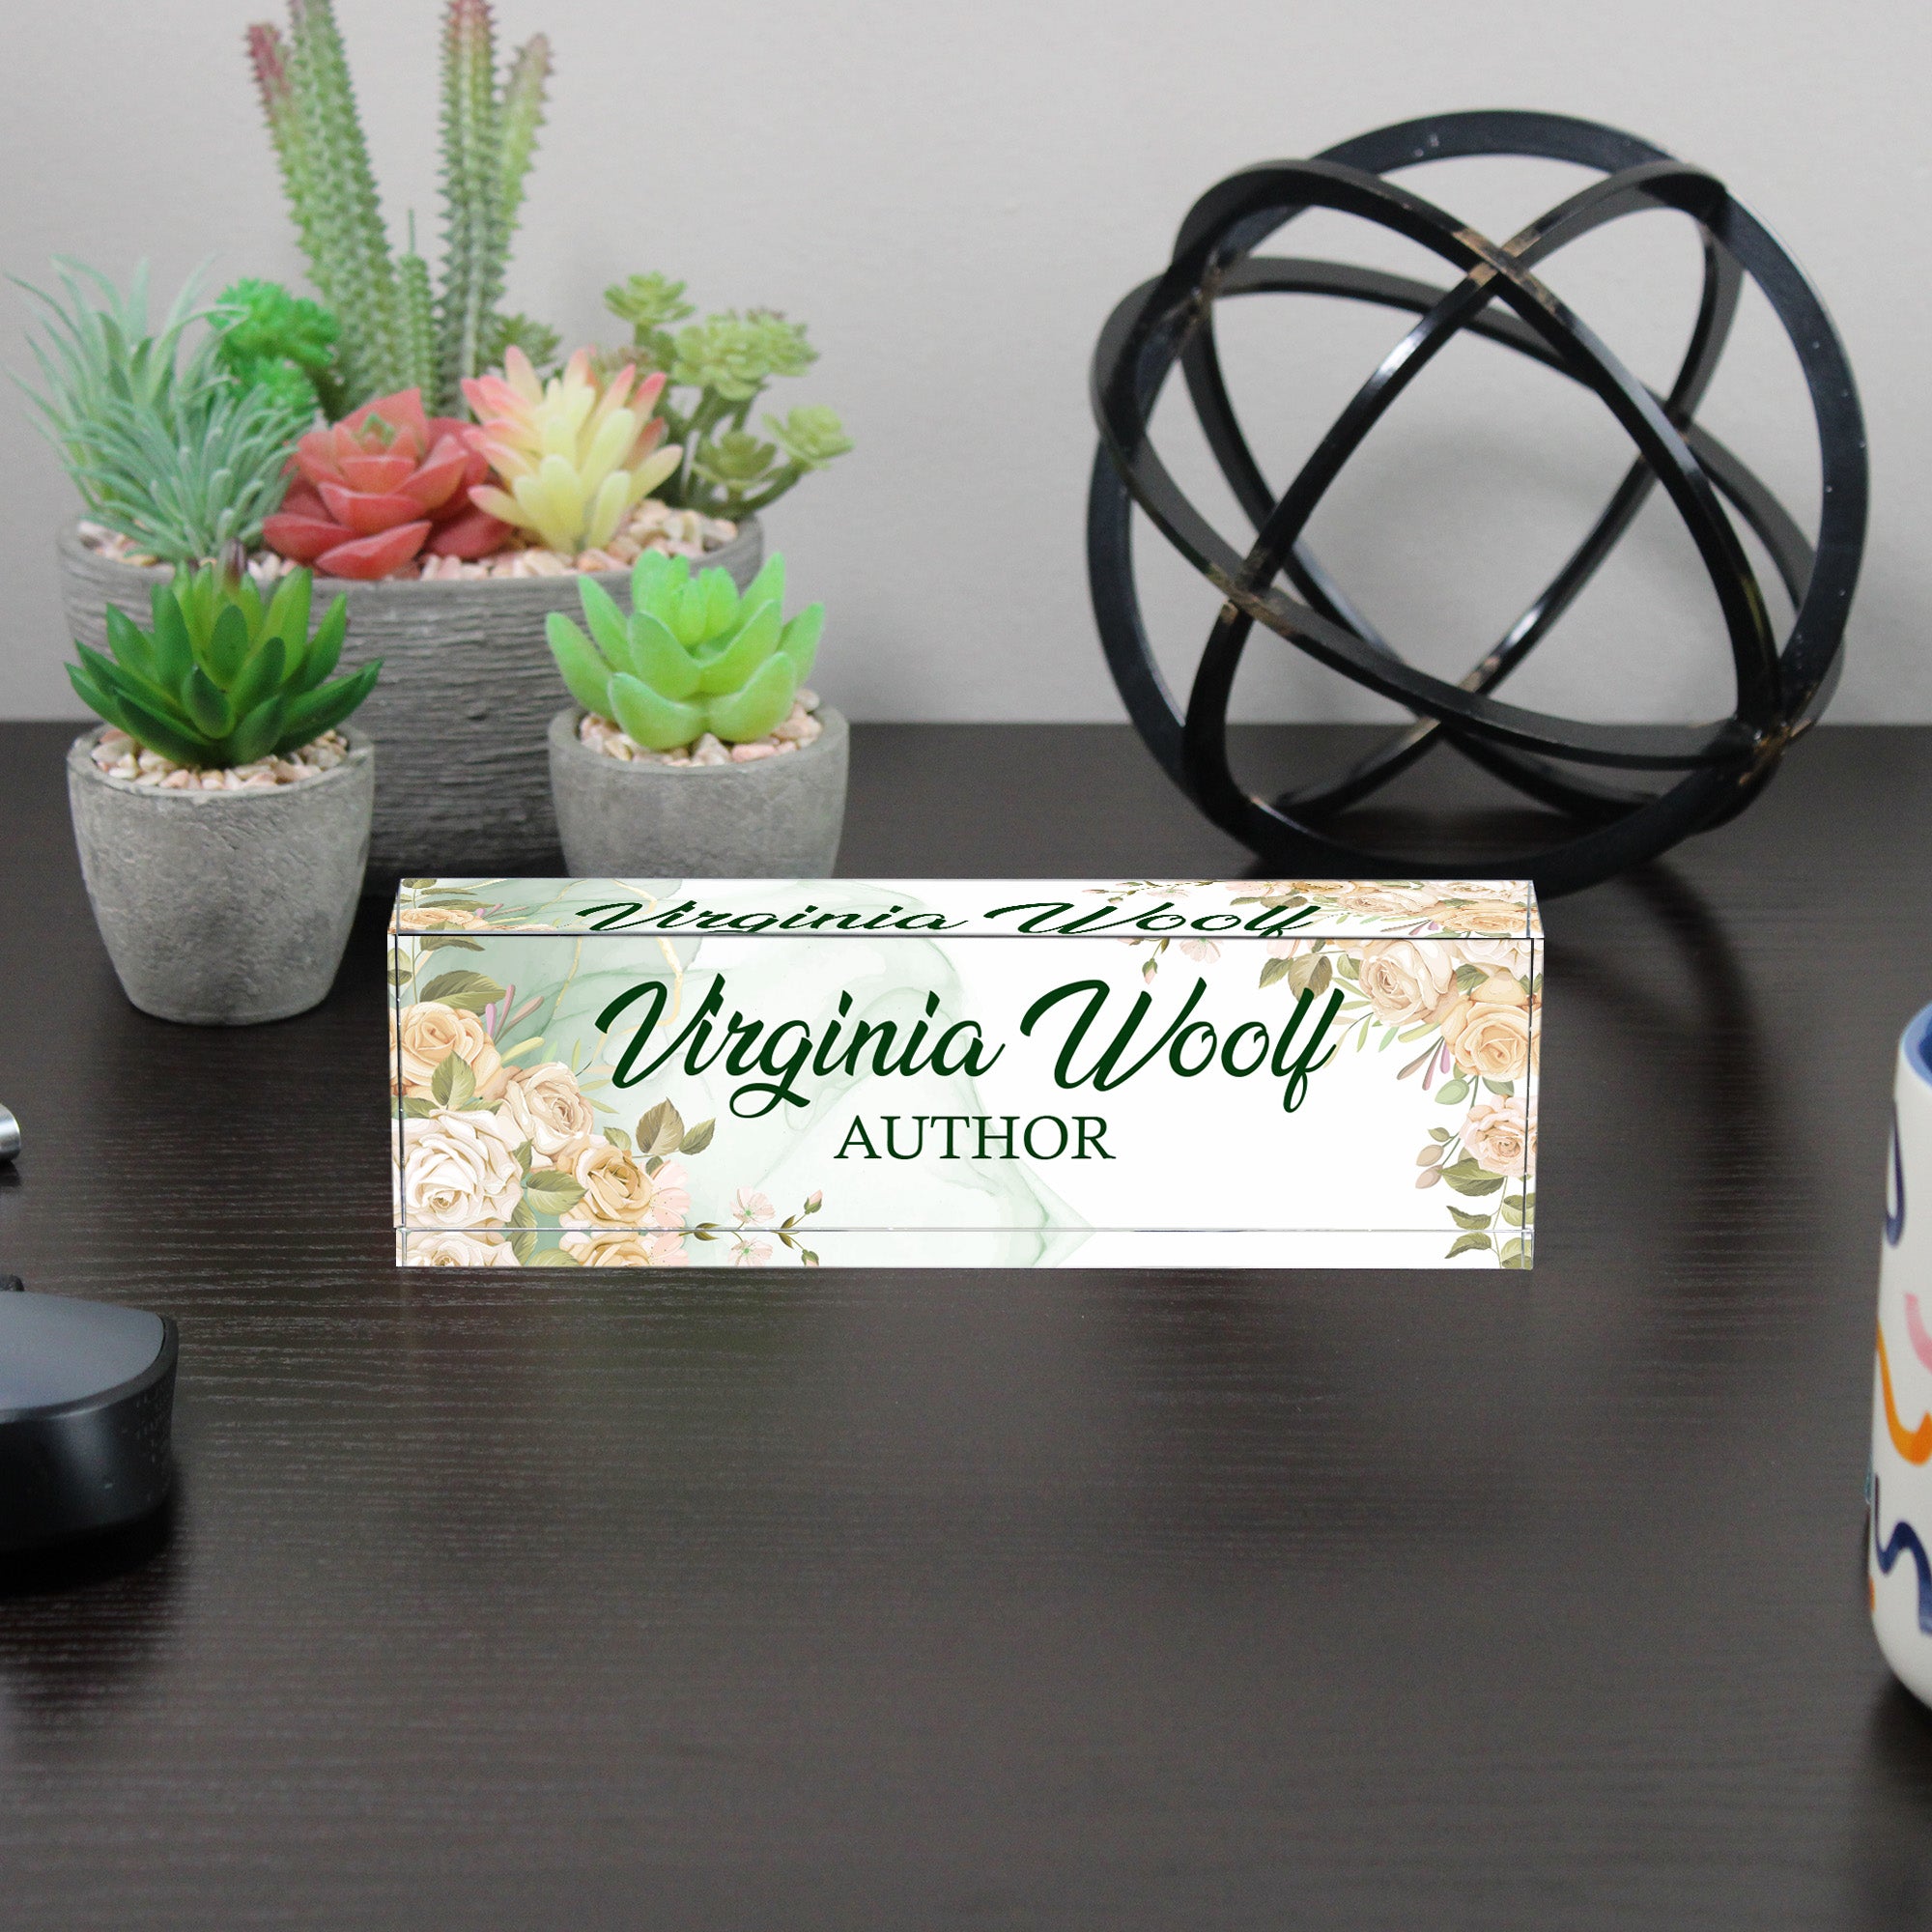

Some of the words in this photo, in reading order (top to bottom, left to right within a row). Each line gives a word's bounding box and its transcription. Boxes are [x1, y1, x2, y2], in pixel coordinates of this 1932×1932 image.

[576, 900, 969, 934] Virginia
[983, 902, 1321, 936] Woolf
[595, 973, 1006, 1119] Virginia
[1020, 977, 1346, 1114] Woolf
[834, 1115, 1117, 1160] AUTHOR
